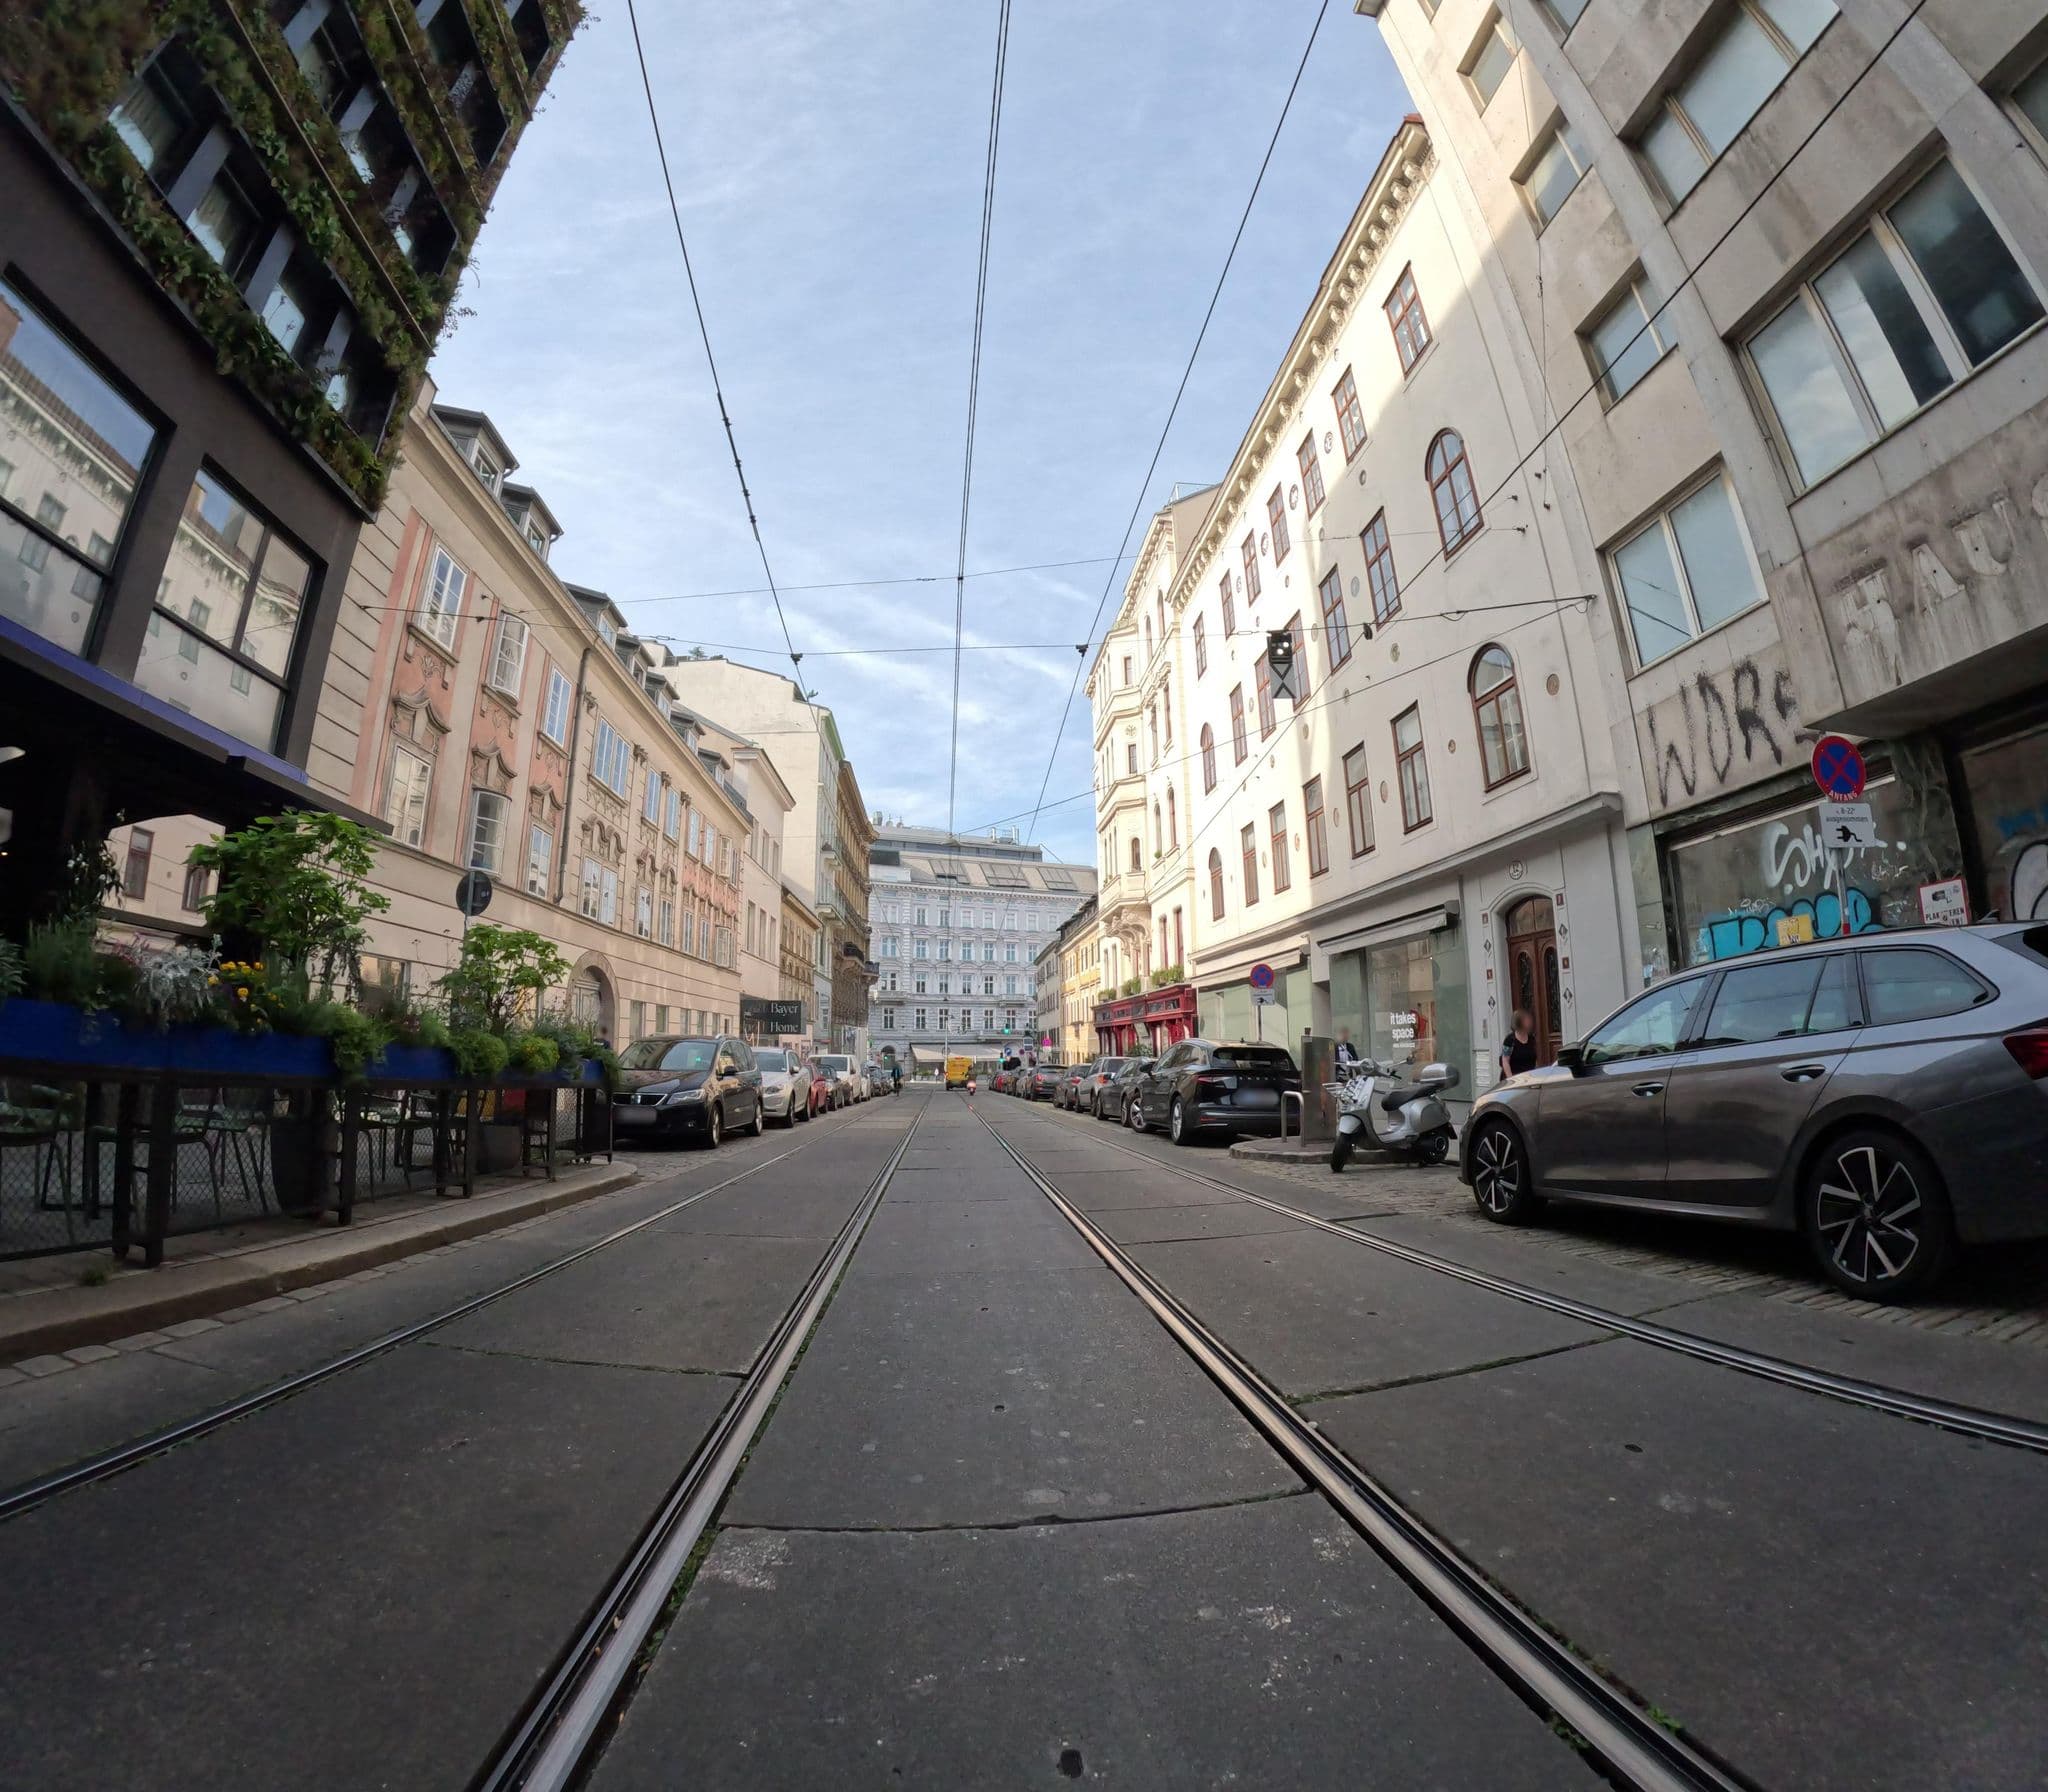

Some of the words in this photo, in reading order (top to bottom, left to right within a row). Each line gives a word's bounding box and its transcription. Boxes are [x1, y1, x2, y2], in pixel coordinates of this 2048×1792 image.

[1828, 789, 1858, 801] ANFANG
[770, 1001, 799, 1017] Bayer
[1395, 1011, 1416, 1025] takes
[770, 1021, 798, 1033] Home
[1391, 1028, 1414, 1042] space
